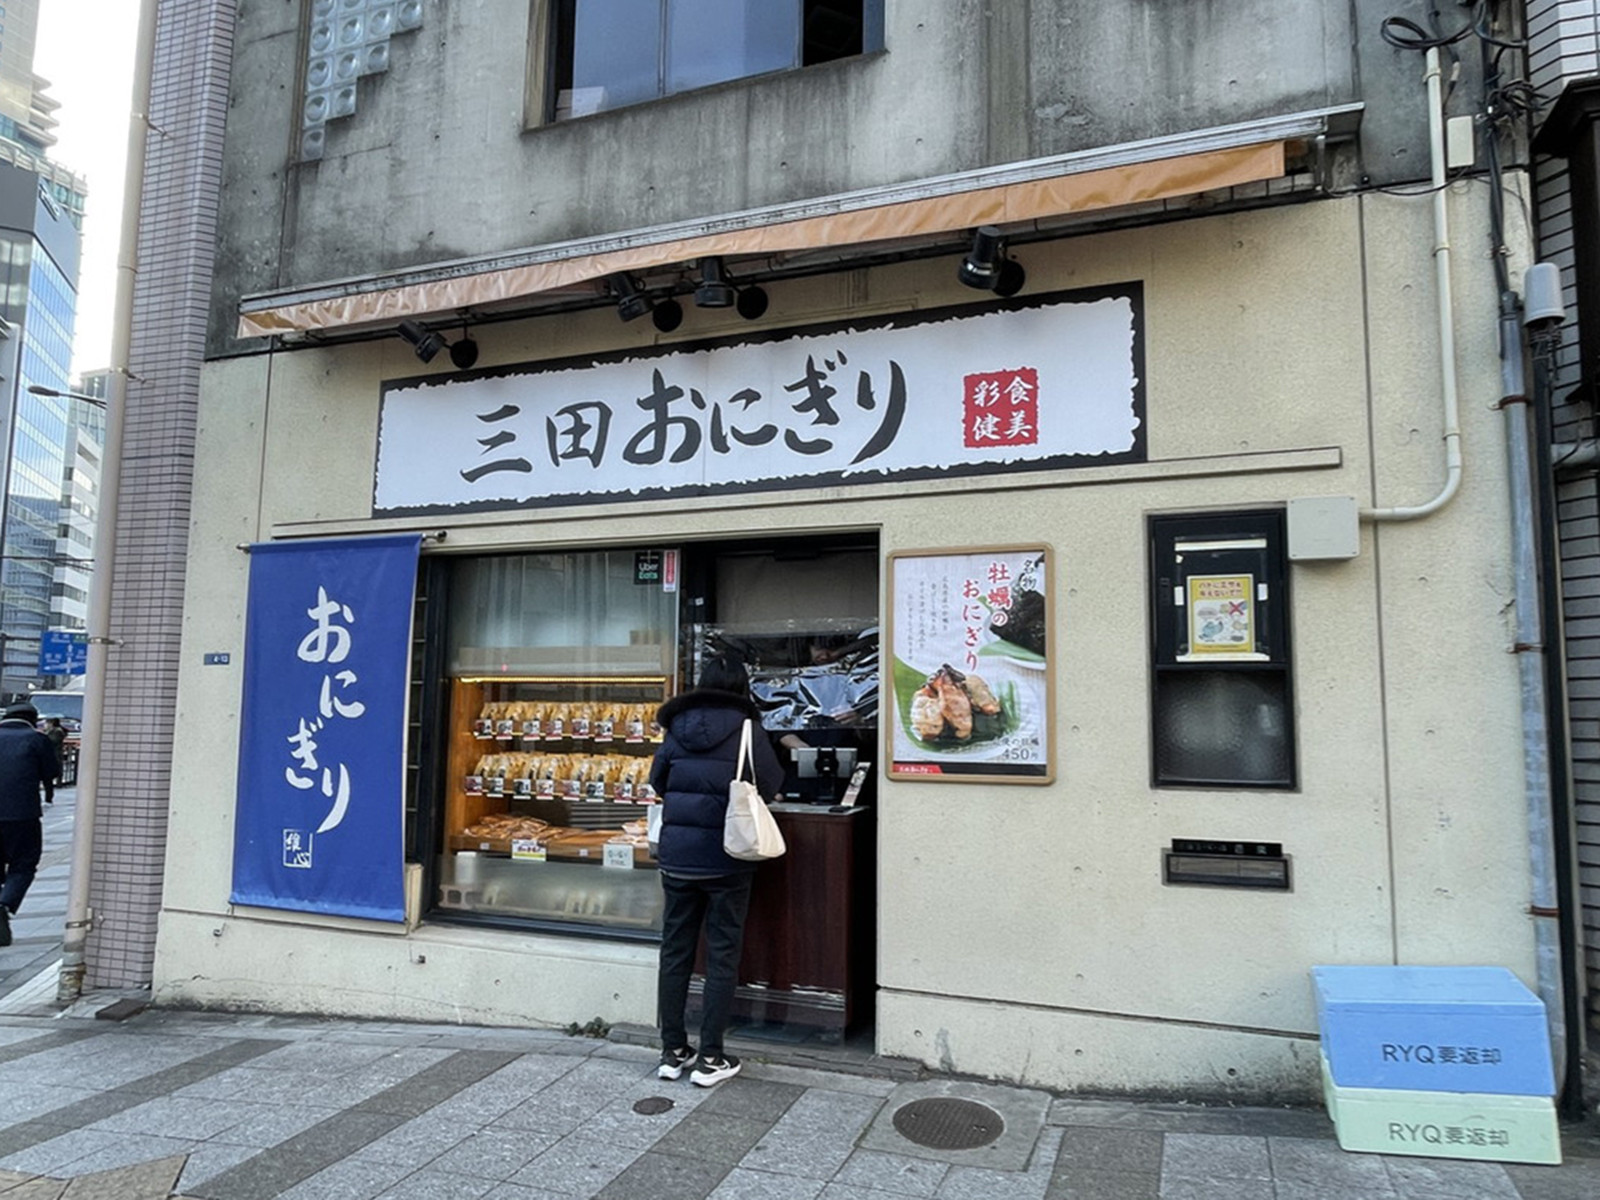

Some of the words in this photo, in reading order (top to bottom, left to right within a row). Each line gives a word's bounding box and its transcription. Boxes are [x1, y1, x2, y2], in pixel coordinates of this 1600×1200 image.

[460, 349, 908, 484] 三田おにぎり
[962, 580, 981, 672] おにぎり
[988, 562, 1012, 627] 牡蠣の
[285, 585, 366, 834] おにぎり
[1381, 1043, 1503, 1067] RYQ要返却
[1388, 1122, 1510, 1148] RYQ要返却
